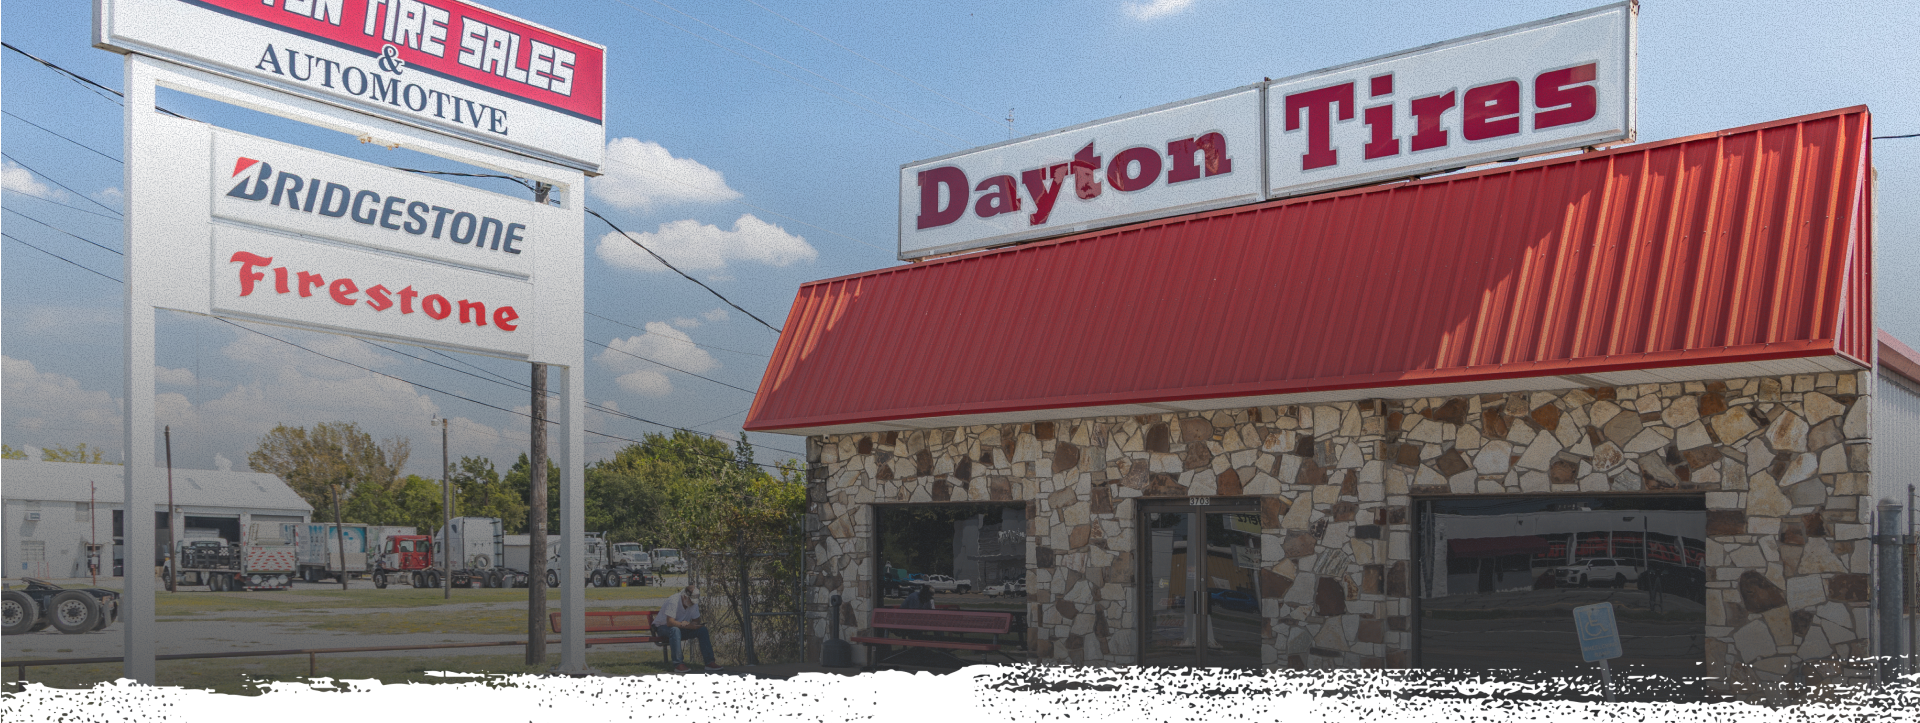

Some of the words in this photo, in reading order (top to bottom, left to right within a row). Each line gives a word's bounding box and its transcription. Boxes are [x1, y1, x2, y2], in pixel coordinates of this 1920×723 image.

[255, 43, 508, 136] AUTOMOTIVE
[363, 0, 450, 58] TIRE
[458, 16, 577, 97] SALES
[379, 45, 405, 76] &
[919, 132, 1232, 228] Dayton
[1285, 63, 1598, 171] Tires
[227, 157, 526, 255] BRIDGESTONE
[230, 250, 520, 332] Firestone
[1190, 497, 1210, 505] 3703
